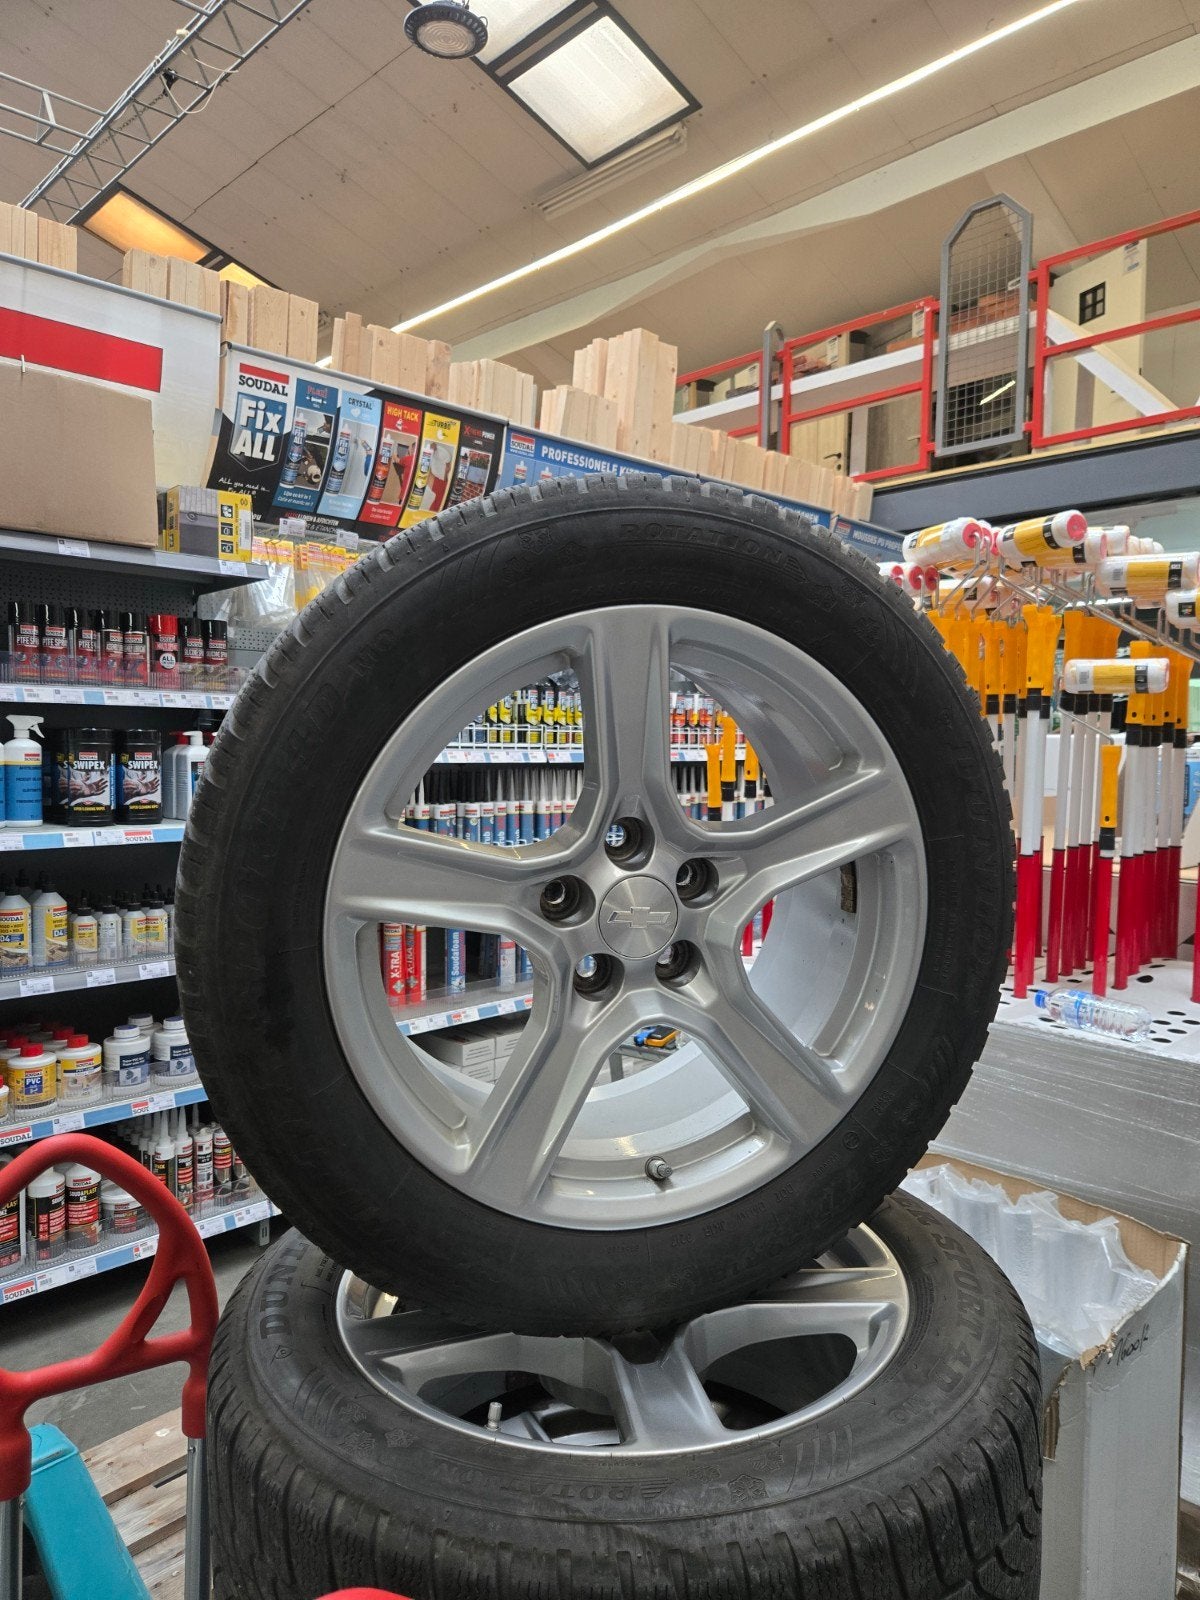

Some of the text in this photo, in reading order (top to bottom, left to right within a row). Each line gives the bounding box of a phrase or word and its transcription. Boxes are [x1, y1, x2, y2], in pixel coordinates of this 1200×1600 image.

[238, 375, 289, 397] SOUDAL
[348, 397, 373, 411] CRYSTAL
[386, 406, 419, 422] HIGH TACK
[233, 429, 277, 462] ALL
[541, 446, 618, 474] PROFESSIONELE
[620, 522, 783, 564] ROTATION
[73, 760, 105, 770] SWIPEX
[128, 760, 159, 769] SWIPEX
[451, 931, 460, 977] Soudafoam
[390, 951, 401, 979] X-TRA
[26, 1077, 41, 1086] PVC
[0, 1133, 32, 1145] SOUDAL
[4, 1287, 35, 1301] SOUDAL
[931, 1232, 986, 1343] SPORT
